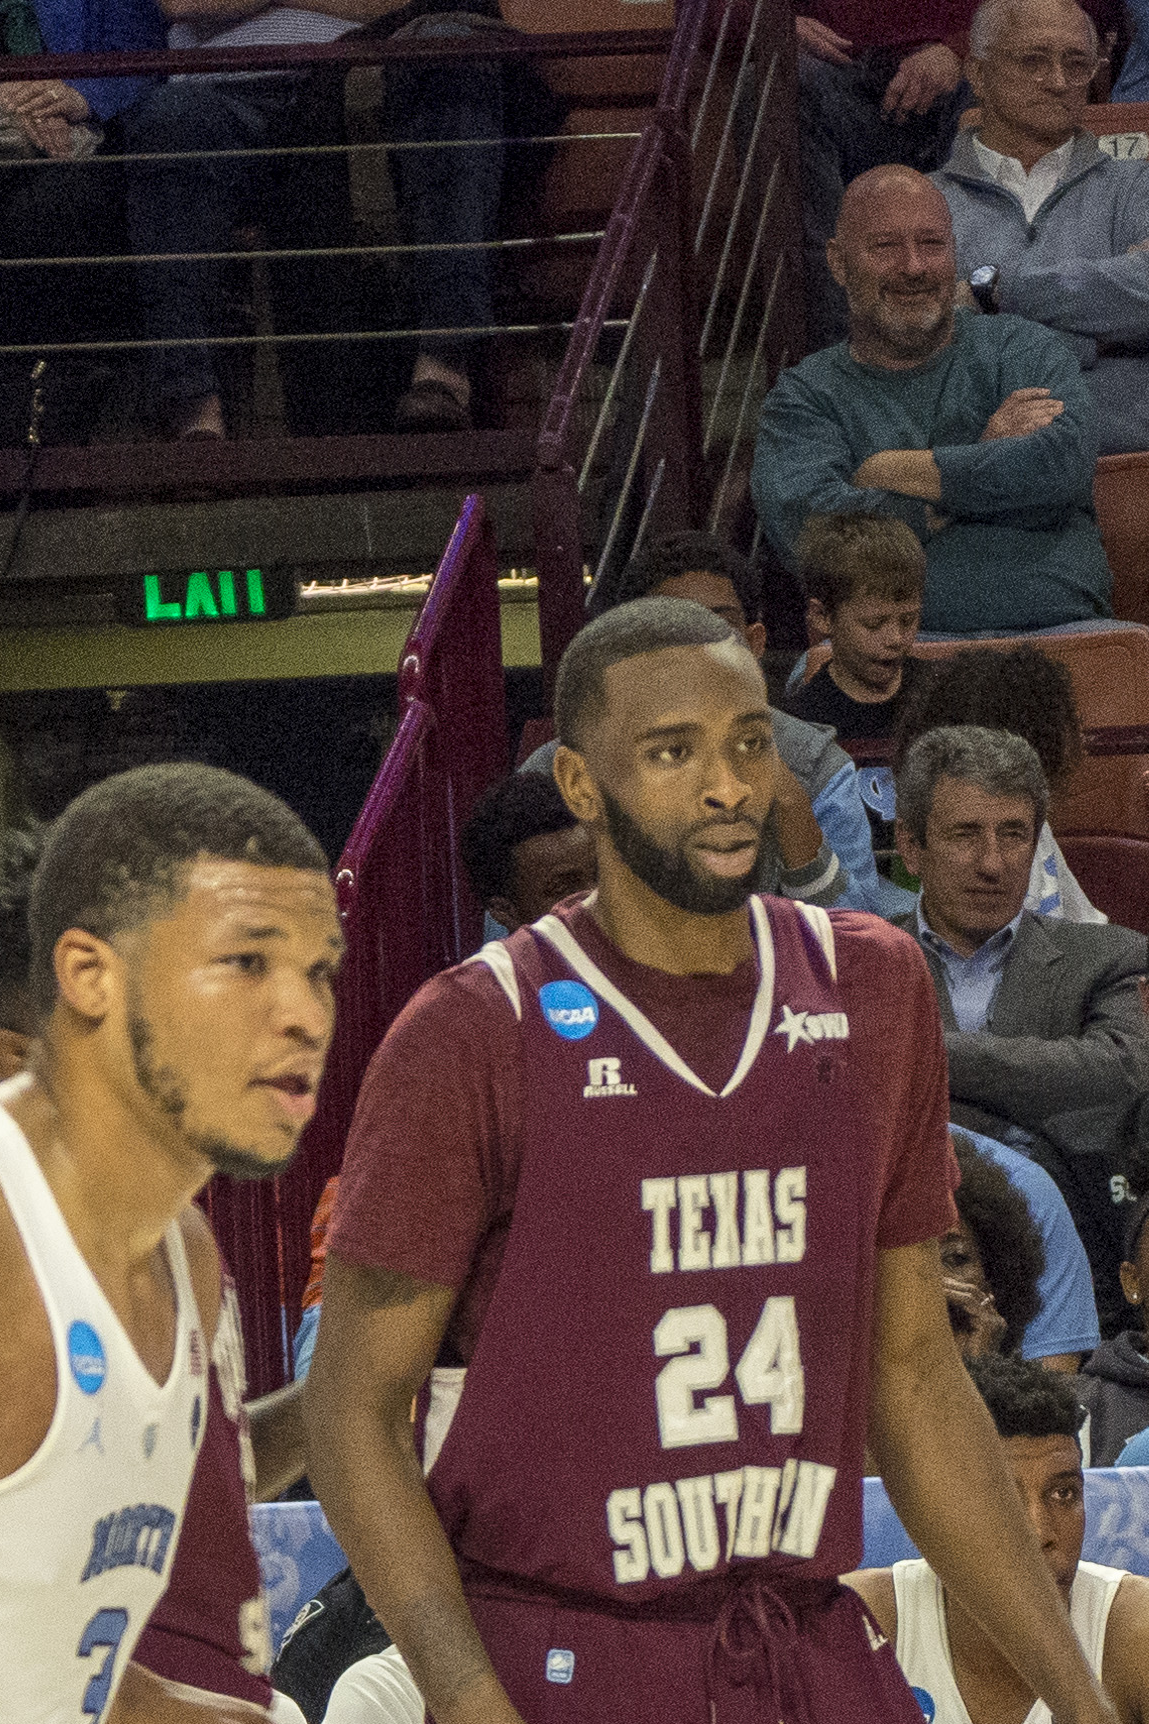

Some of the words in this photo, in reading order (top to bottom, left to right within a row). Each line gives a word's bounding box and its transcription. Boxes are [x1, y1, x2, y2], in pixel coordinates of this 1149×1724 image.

[1108, 136, 1140, 158] 17
[640, 1165, 808, 1275] TEXAS
[653, 1295, 807, 1450] 24
